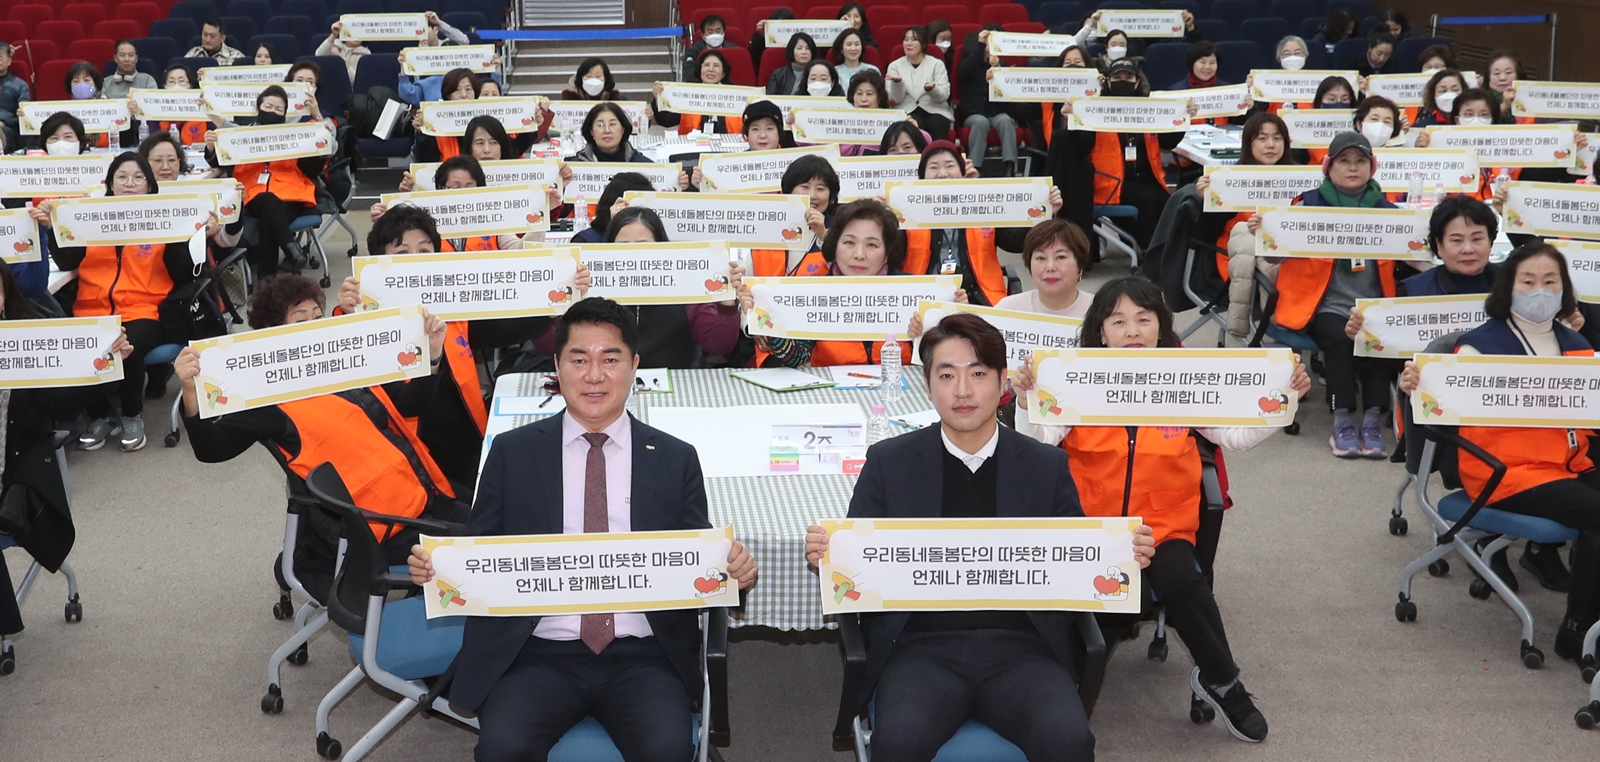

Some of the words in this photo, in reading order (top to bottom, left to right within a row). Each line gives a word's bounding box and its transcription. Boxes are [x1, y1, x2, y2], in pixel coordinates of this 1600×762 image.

[1051, 77, 1069, 85] 따뜻한
[1527, 91, 1579, 99] 우리동네돌봄단의
[1580, 92, 1600, 100] 따뜻한
[505, 106, 523, 114] 마음이
[1546, 100, 1566, 108] 언제나
[1084, 106, 1134, 114] 우리동네돌봄단의
[1156, 107, 1175, 115] 마음이
[1103, 115, 1122, 123] 언제나
[1293, 120, 1346, 128] 우리동네돌봄단의
[230, 134, 278, 145] 우리동네돌봄단의
[278, 133, 297, 141] 따뜻한
[297, 131, 316, 139] 마음이
[1445, 137, 1507, 146] 우리동네돌봄단의
[1509, 137, 1533, 145] 따뜻한
[1534, 137, 1558, 145] 마음이
[249, 144, 267, 153] 언제나
[268, 142, 300, 151] 함께합니다.
[1493, 147, 1535, 156] 함께합니다.
[57, 166, 80, 174] 따뜻한
[81, 166, 103, 174] 마음이
[717, 160, 776, 173] 우리동네돌봄단의
[1419, 161, 1441, 170] 따뜻한
[1442, 161, 1464, 169] 마음이
[19, 177, 42, 185] 언제나
[43, 176, 83, 185] 함께합니다.
[495, 173, 519, 182] 따뜻한
[521, 172, 544, 180] 마음이
[740, 172, 763, 182] 언제나
[1381, 172, 1403, 180] 언제나
[578, 183, 601, 192] 언제나
[857, 180, 881, 190] 언제나
[1224, 179, 1286, 188] 우리동네돌봄단의
[1288, 178, 1312, 188] 따뜻한
[907, 194, 975, 204] 우리동네돌봄단의
[978, 193, 1004, 203] 따뜻한
[1006, 193, 1032, 202] 마음이
[1247, 190, 1271, 199] 언제나
[475, 200, 502, 211] 따뜻한
[503, 199, 529, 209] 마음이
[933, 206, 959, 216] 언제나
[960, 205, 1007, 215] 함께합니다.
[1523, 198, 1598, 211] 우리동네돌봄단의
[74, 209, 142, 222] 우리동네돌봄단의
[144, 208, 170, 218] 따뜻한
[172, 207, 198, 217] 마음이
[459, 213, 506, 225] 함께합니다.
[727, 210, 756, 221] 따뜻한
[758, 211, 786, 221] 마음이
[1551, 212, 1580, 224] 언제나
[100, 223, 127, 233] 언제나
[128, 220, 174, 232] 함께합니다.
[677, 222, 706, 233] 언제나
[707, 223, 758, 234] 함께합니다.
[1279, 221, 1353, 232] 우리동네돌봄단의
[1355, 223, 1383, 233] 따뜻한
[1385, 224, 1413, 234] 마음이
[1307, 234, 1335, 244] 언제나
[1336, 235, 1385, 246] 함께합니다.
[640, 259, 673, 271] 따뜻한
[676, 259, 709, 270] 마음이
[385, 272, 478, 288] 우리동네돌봄단의
[482, 270, 517, 284] 따뜻한
[520, 269, 554, 282] 마음이
[618, 275, 677, 287] 함께합니다.
[421, 291, 456, 304] 언제나
[458, 288, 521, 303] 함께합니다.
[772, 295, 862, 307] 우리동네돌봄단의
[865, 294, 899, 307] 따뜻한
[806, 311, 840, 323] 언제나
[843, 311, 903, 323] 함께합니다.
[1384, 311, 1471, 326] 우리동네돌봄단의
[22, 338, 59, 351] 따뜻한
[62, 337, 98, 350] 마음이
[225, 342, 324, 372] 우리동네돌봄단의
[327, 335, 364, 354] 따뜻한
[366, 329, 403, 347] 마음이
[0, 355, 64, 370] 함께합니다.
[265, 365, 302, 384] 언제나
[304, 354, 370, 377] 함께합니다.
[1065, 371, 1175, 385] 우리동네돌봄단의
[1179, 372, 1221, 386] 따뜻한
[1224, 373, 1266, 386] 마음이
[1445, 375, 1545, 389] 우리동네돌봄단의
[1548, 377, 1586, 391] 따뜻한
[1106, 390, 1147, 403] 언제나
[1151, 390, 1223, 404] 함께합니다.
[1482, 393, 1519, 407] 언제나
[1522, 394, 1588, 408] 함께합니다.
[862, 546, 993, 563] 우리동네돌봄단의
[998, 545, 1048, 563] 따뜻한
[1052, 546, 1101, 562] 마음이
[466, 554, 594, 573] 우리동네돌봄단의
[599, 552, 647, 569] 따뜻한
[652, 551, 700, 567] 마음이
[912, 569, 962, 586] 언제나
[965, 568, 1052, 586] 함께합니다.
[516, 577, 564, 593] 언제나
[568, 574, 654, 592] 함께합니다.
